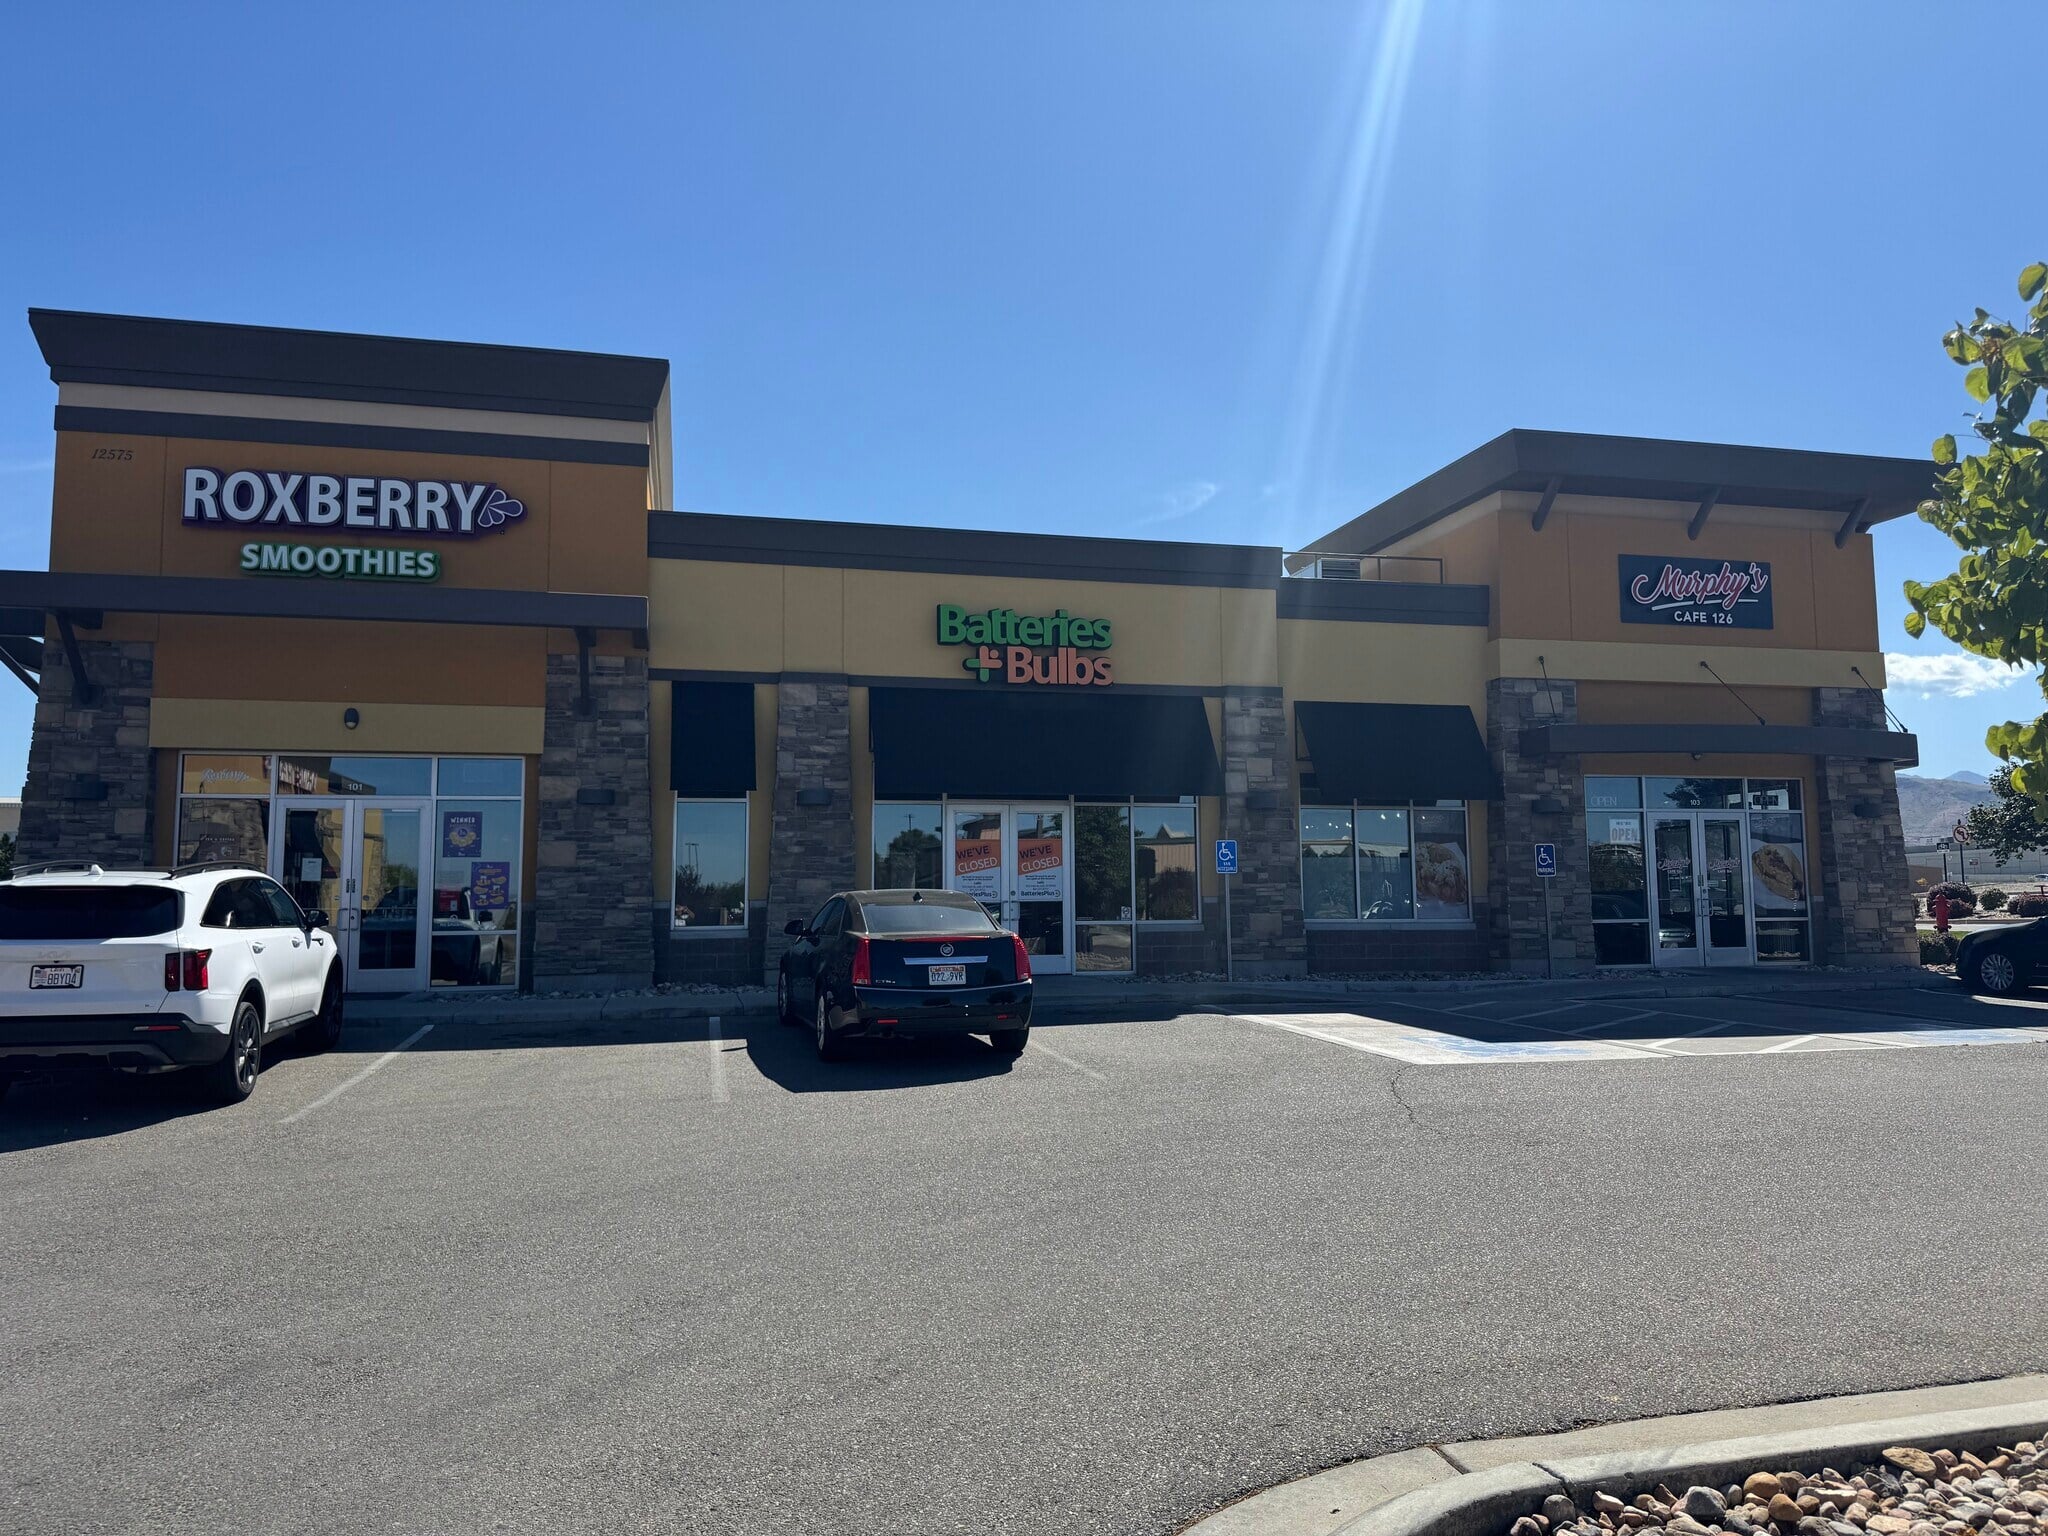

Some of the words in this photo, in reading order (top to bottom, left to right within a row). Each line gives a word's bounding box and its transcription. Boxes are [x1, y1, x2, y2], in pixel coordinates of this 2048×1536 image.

[91, 448, 134, 461] 12575
[183, 467, 487, 532] ROXBERRY
[240, 542, 438, 578] SMOOTHIES
[1631, 562, 1768, 610] Murphy's
[1674, 611, 1707, 623] CAFE
[1712, 612, 1733, 624] 126
[938, 604, 1112, 648] Batteries
[1007, 646, 1114, 686] Bulbs
[348, 783, 363, 791] 101
[1591, 796, 1617, 806] OPEN
[1611, 828, 1638, 841] OPEN
[956, 845, 990, 859] WE'VE
[1020, 845, 1052, 859] WE'VE
[958, 857, 998, 873] CLOSED
[1021, 856, 1060, 872] CLOSED
